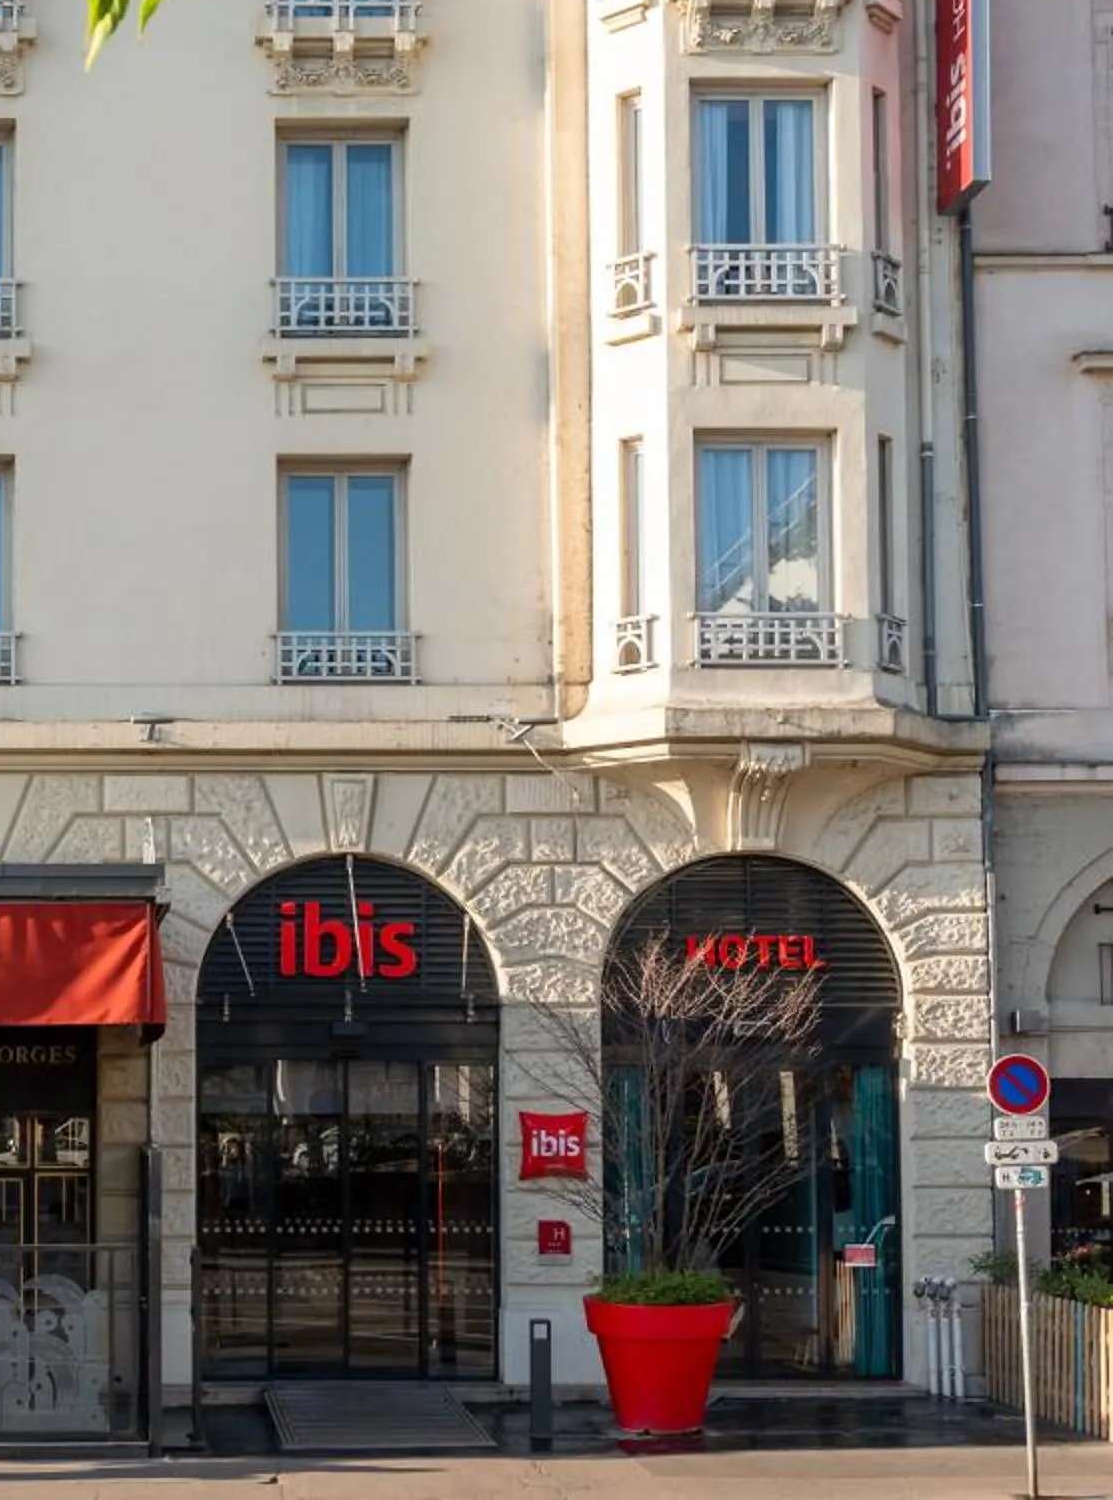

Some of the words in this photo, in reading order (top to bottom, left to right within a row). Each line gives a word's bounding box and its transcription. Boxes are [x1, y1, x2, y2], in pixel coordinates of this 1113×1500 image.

[946, 52, 967, 170] ibis
[280, 901, 417, 977] ibis
[684, 934, 827, 969] HOTEL
[531, 1129, 580, 1157] ibis
[553, 1227, 565, 1241] H
